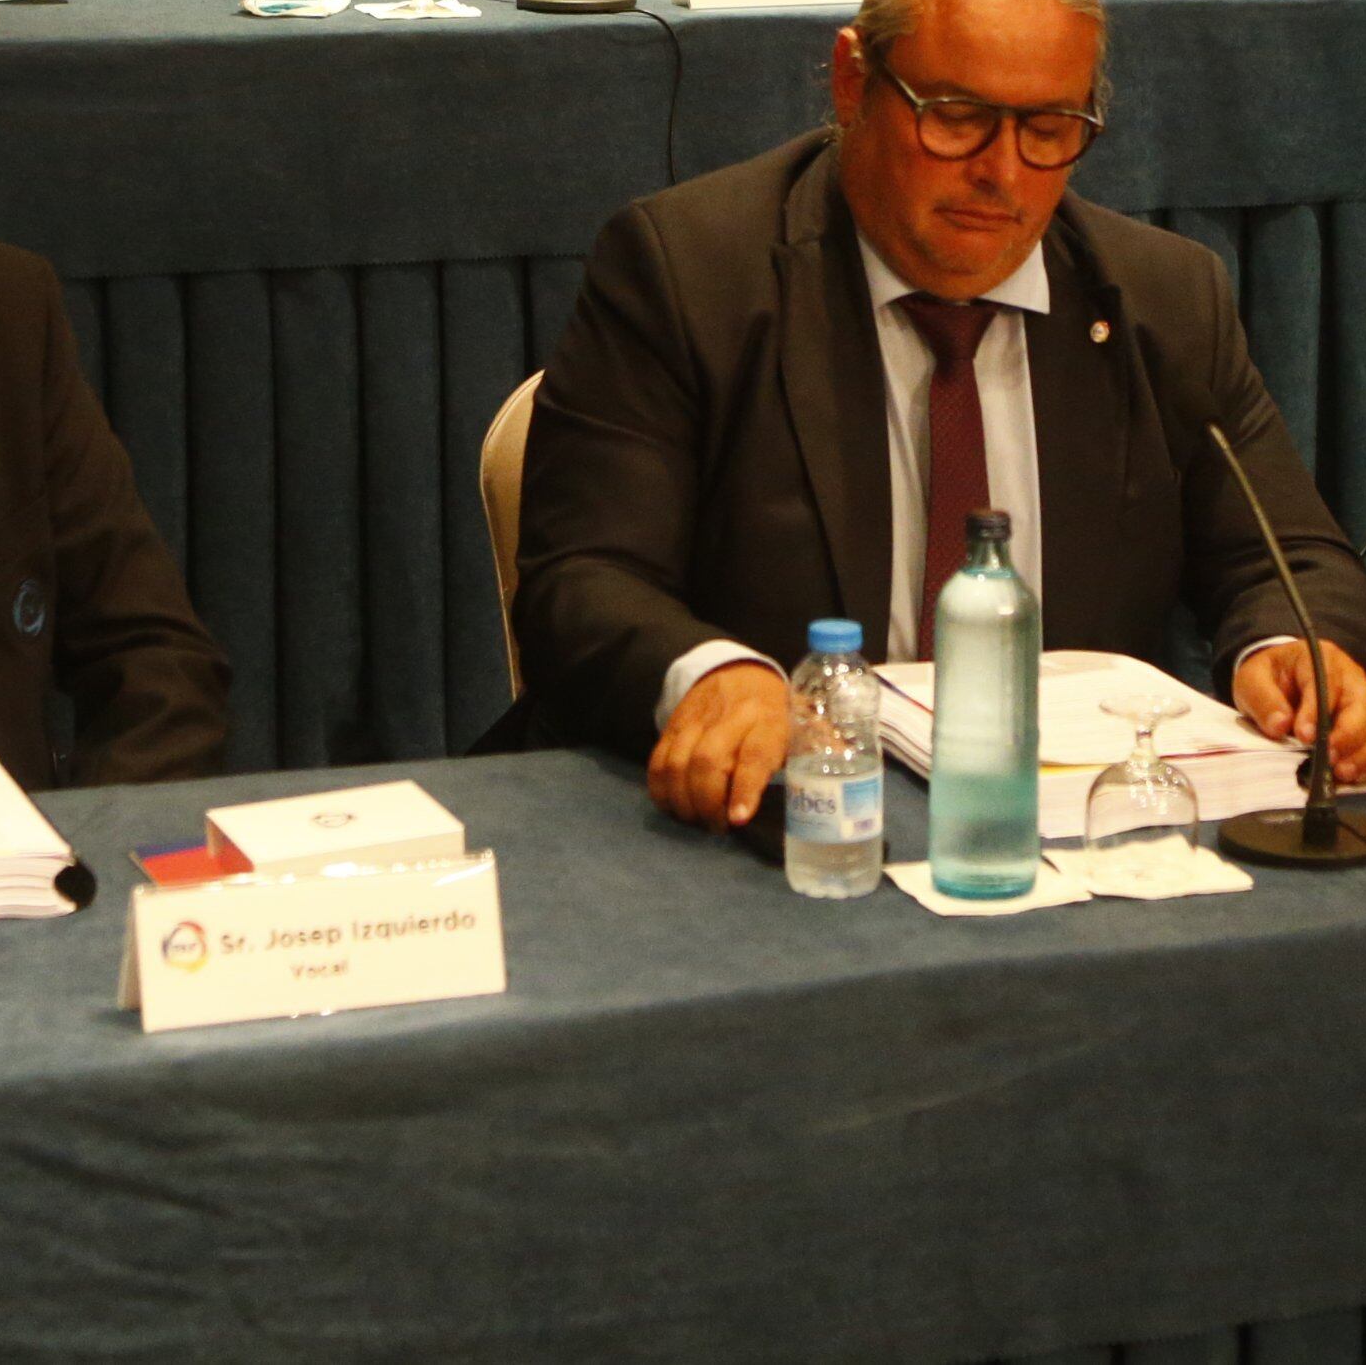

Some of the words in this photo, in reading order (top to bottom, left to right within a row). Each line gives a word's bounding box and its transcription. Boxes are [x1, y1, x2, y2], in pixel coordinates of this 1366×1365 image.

[219, 933, 255, 956] Sr.
[264, 923, 342, 951] Josep
[351, 909, 477, 943] Izquierdo
[290, 959, 349, 981] Vocal
